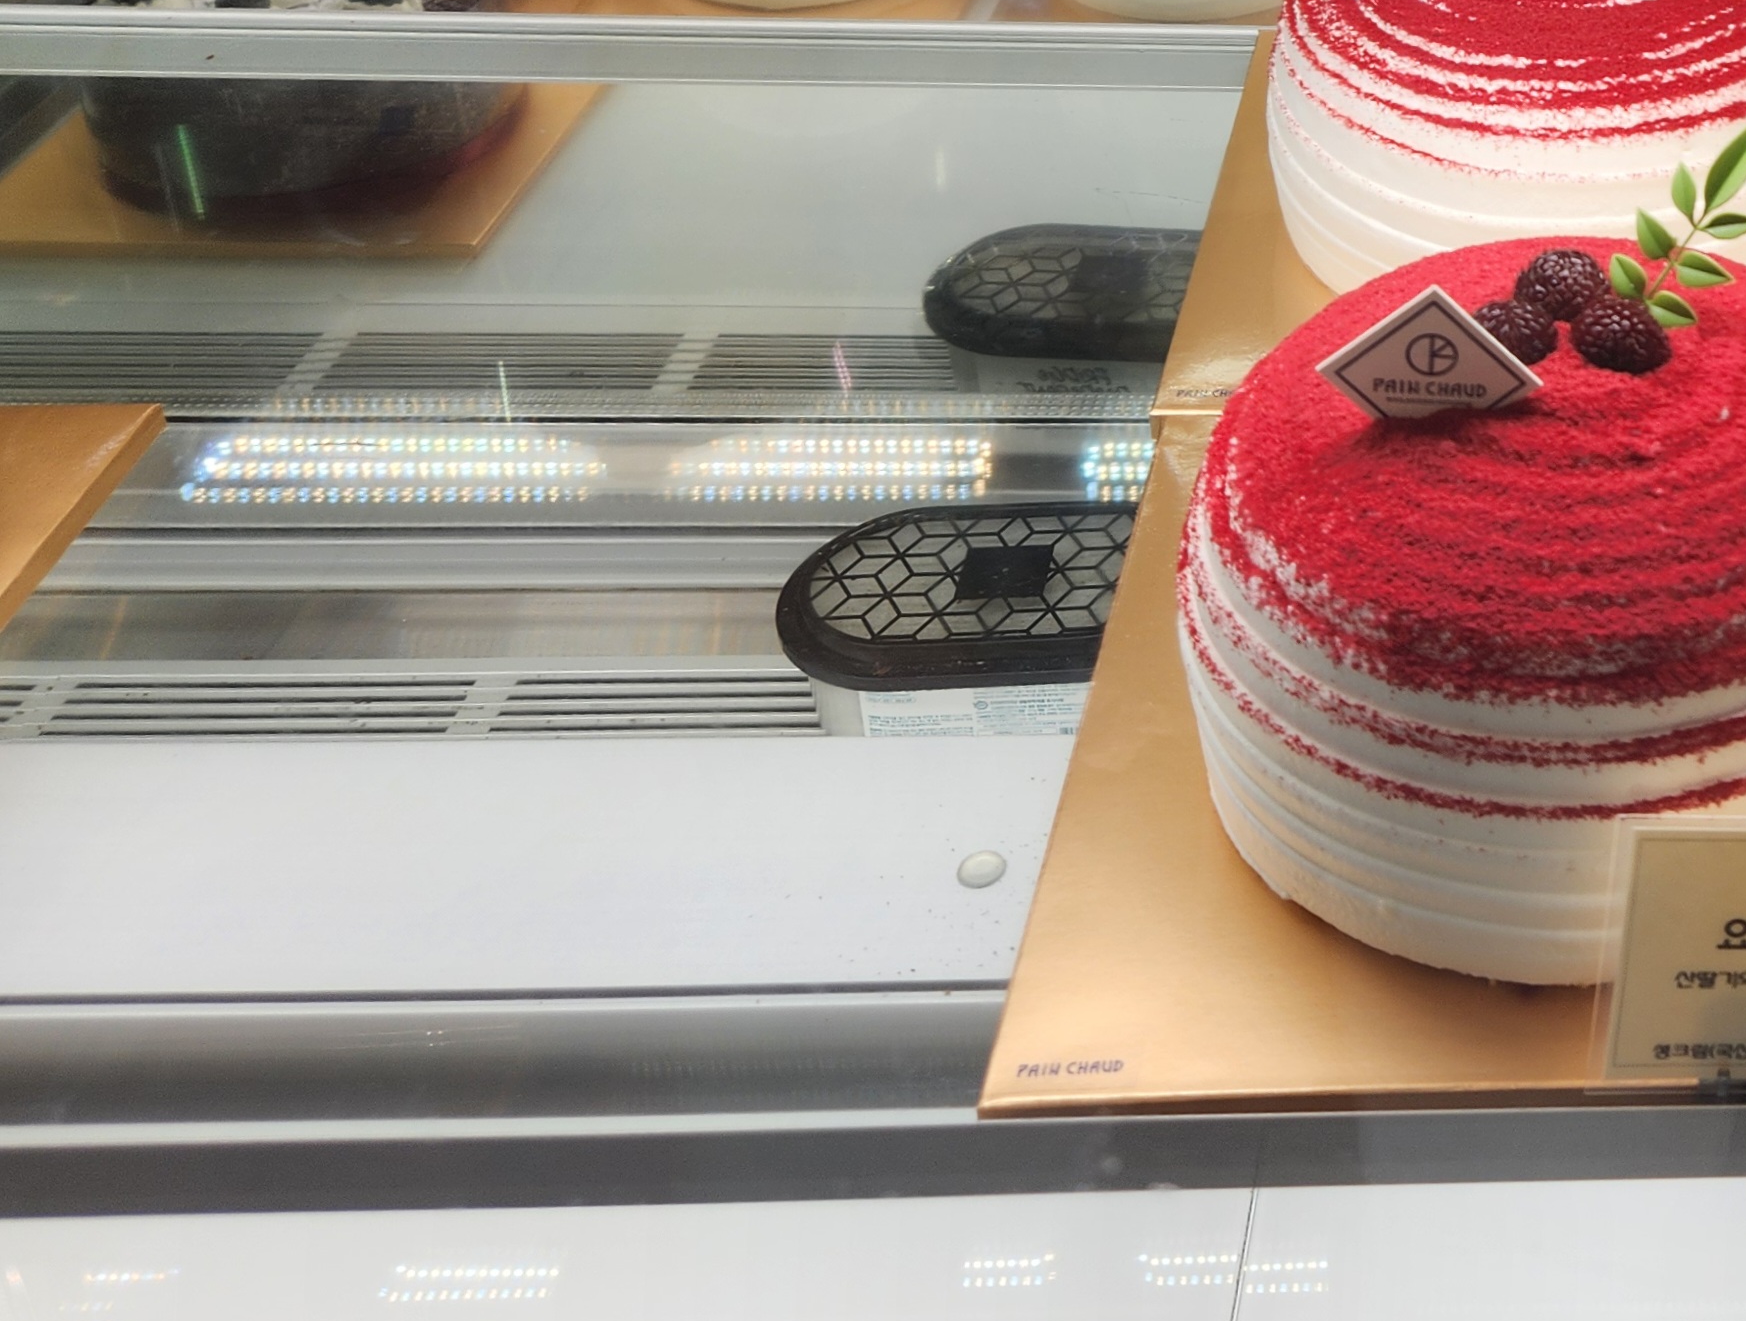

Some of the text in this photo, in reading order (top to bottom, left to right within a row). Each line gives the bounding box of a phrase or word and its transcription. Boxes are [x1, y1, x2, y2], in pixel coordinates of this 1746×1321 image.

[1372, 377, 1488, 398] PAIN CHAUD
[1016, 1059, 1125, 1077] PAIN CHAUD
